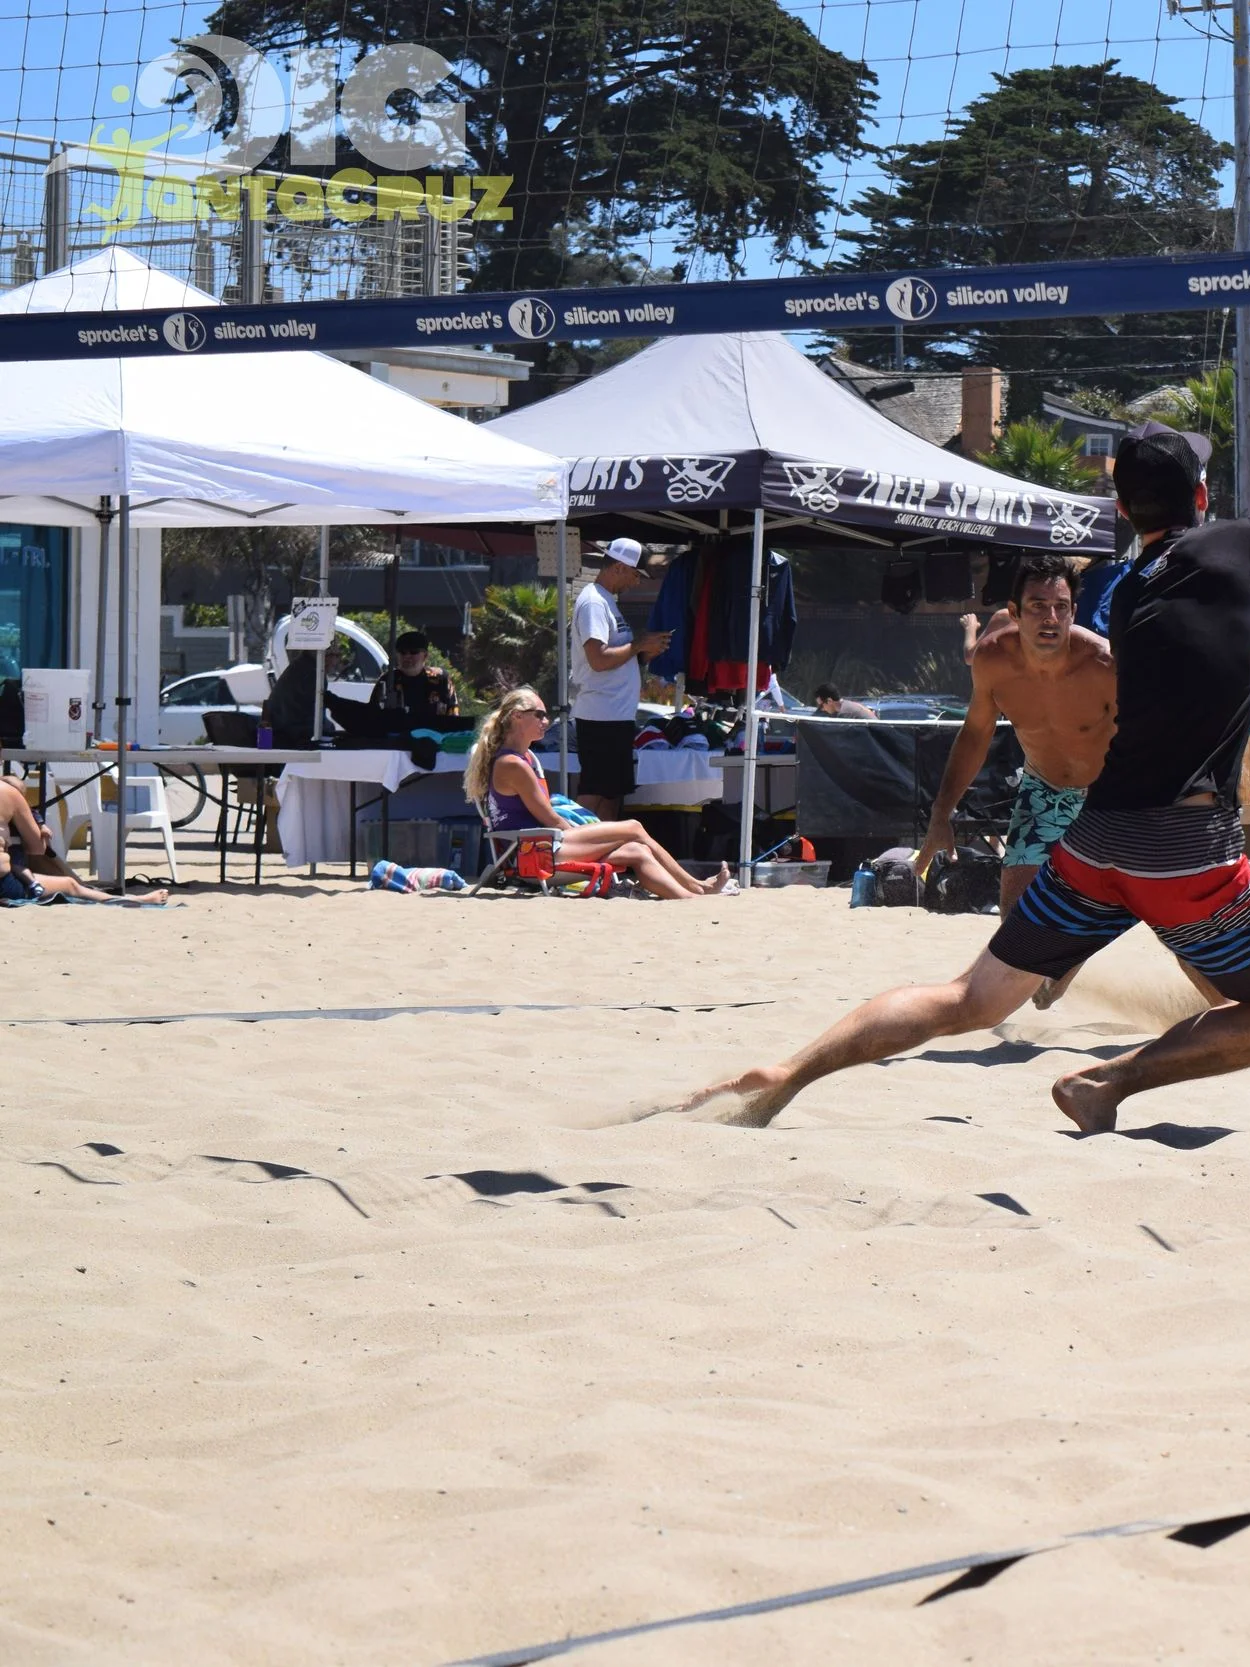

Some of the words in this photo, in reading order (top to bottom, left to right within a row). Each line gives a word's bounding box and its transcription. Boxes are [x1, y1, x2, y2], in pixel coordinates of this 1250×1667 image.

[785, 292, 879, 316] sprocket's
[947, 286, 1008, 306] silicon
[1013, 282, 1068, 304] volley
[78, 325, 158, 345] sprocket's
[214, 322, 266, 339] silicon
[270, 320, 316, 339] volley
[416, 312, 503, 334] sprocket's
[564, 307, 620, 325] silicon
[624, 304, 675, 324] volley
[568, 456, 650, 491] ORTS
[569, 494, 596, 507] EYBALL
[945, 482, 1036, 527] SPORTS
[917, 516, 937, 529] CRUZ
